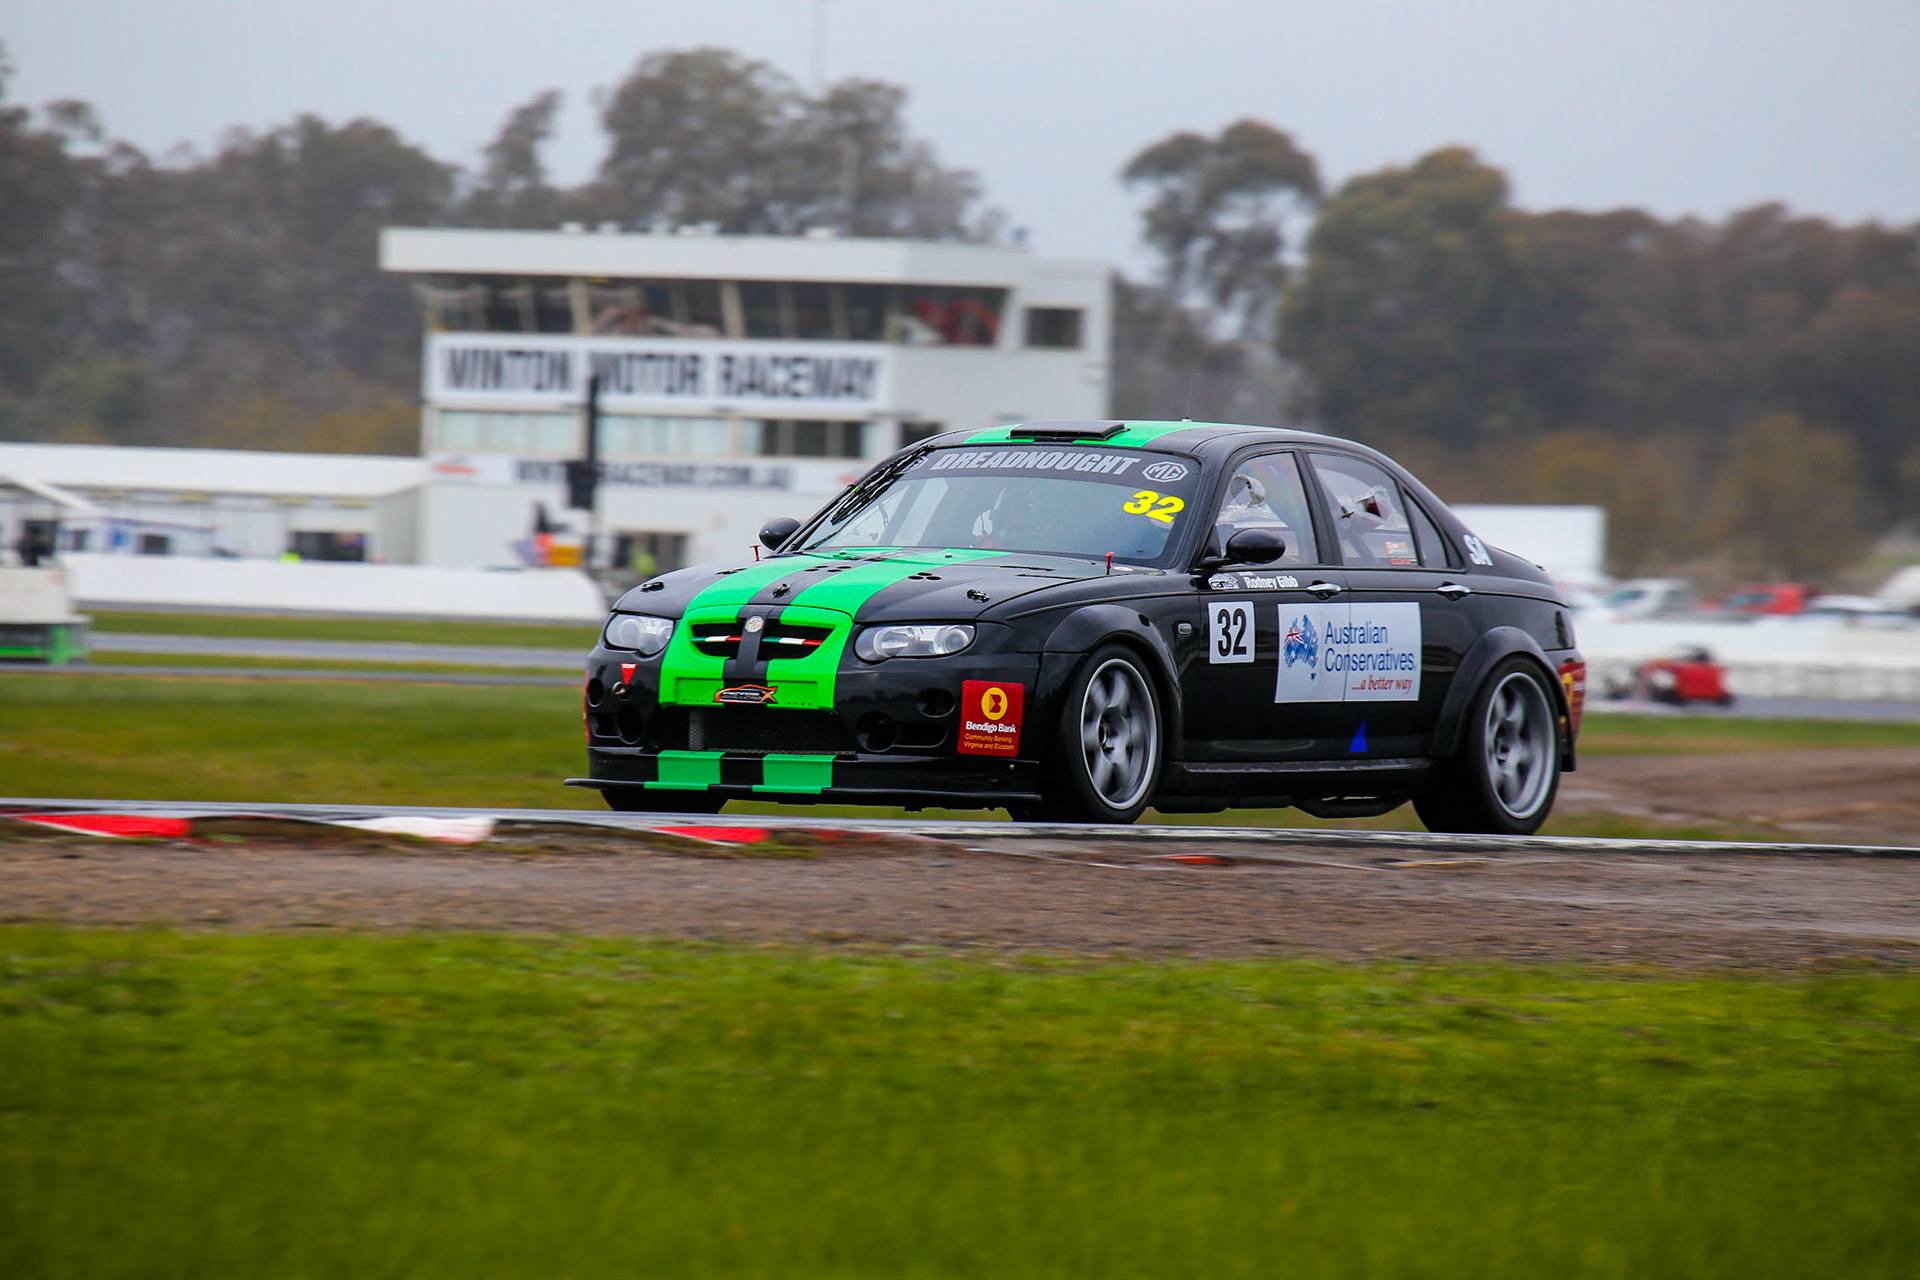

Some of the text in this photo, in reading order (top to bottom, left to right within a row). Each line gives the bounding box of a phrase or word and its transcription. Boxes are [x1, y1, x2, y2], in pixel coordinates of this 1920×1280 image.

[448, 350, 881, 399] WINTON MOTOR RACEWAY
[930, 451, 1142, 476] DREADNOUGHT
[1147, 463, 1183, 481] MG
[1123, 490, 1185, 524] 32
[1463, 534, 1494, 567] SA
[1243, 576, 1278, 590] Rodney
[1217, 608, 1247, 657] 32
[1325, 621, 1388, 645] Australian
[1324, 648, 1415, 673] Conservatives
[1367, 674, 1394, 691] better
[1395, 678, 1413, 695] way
[964, 734, 1012, 744] Community Banking
[966, 721, 1016, 733] Bendigo Bank
